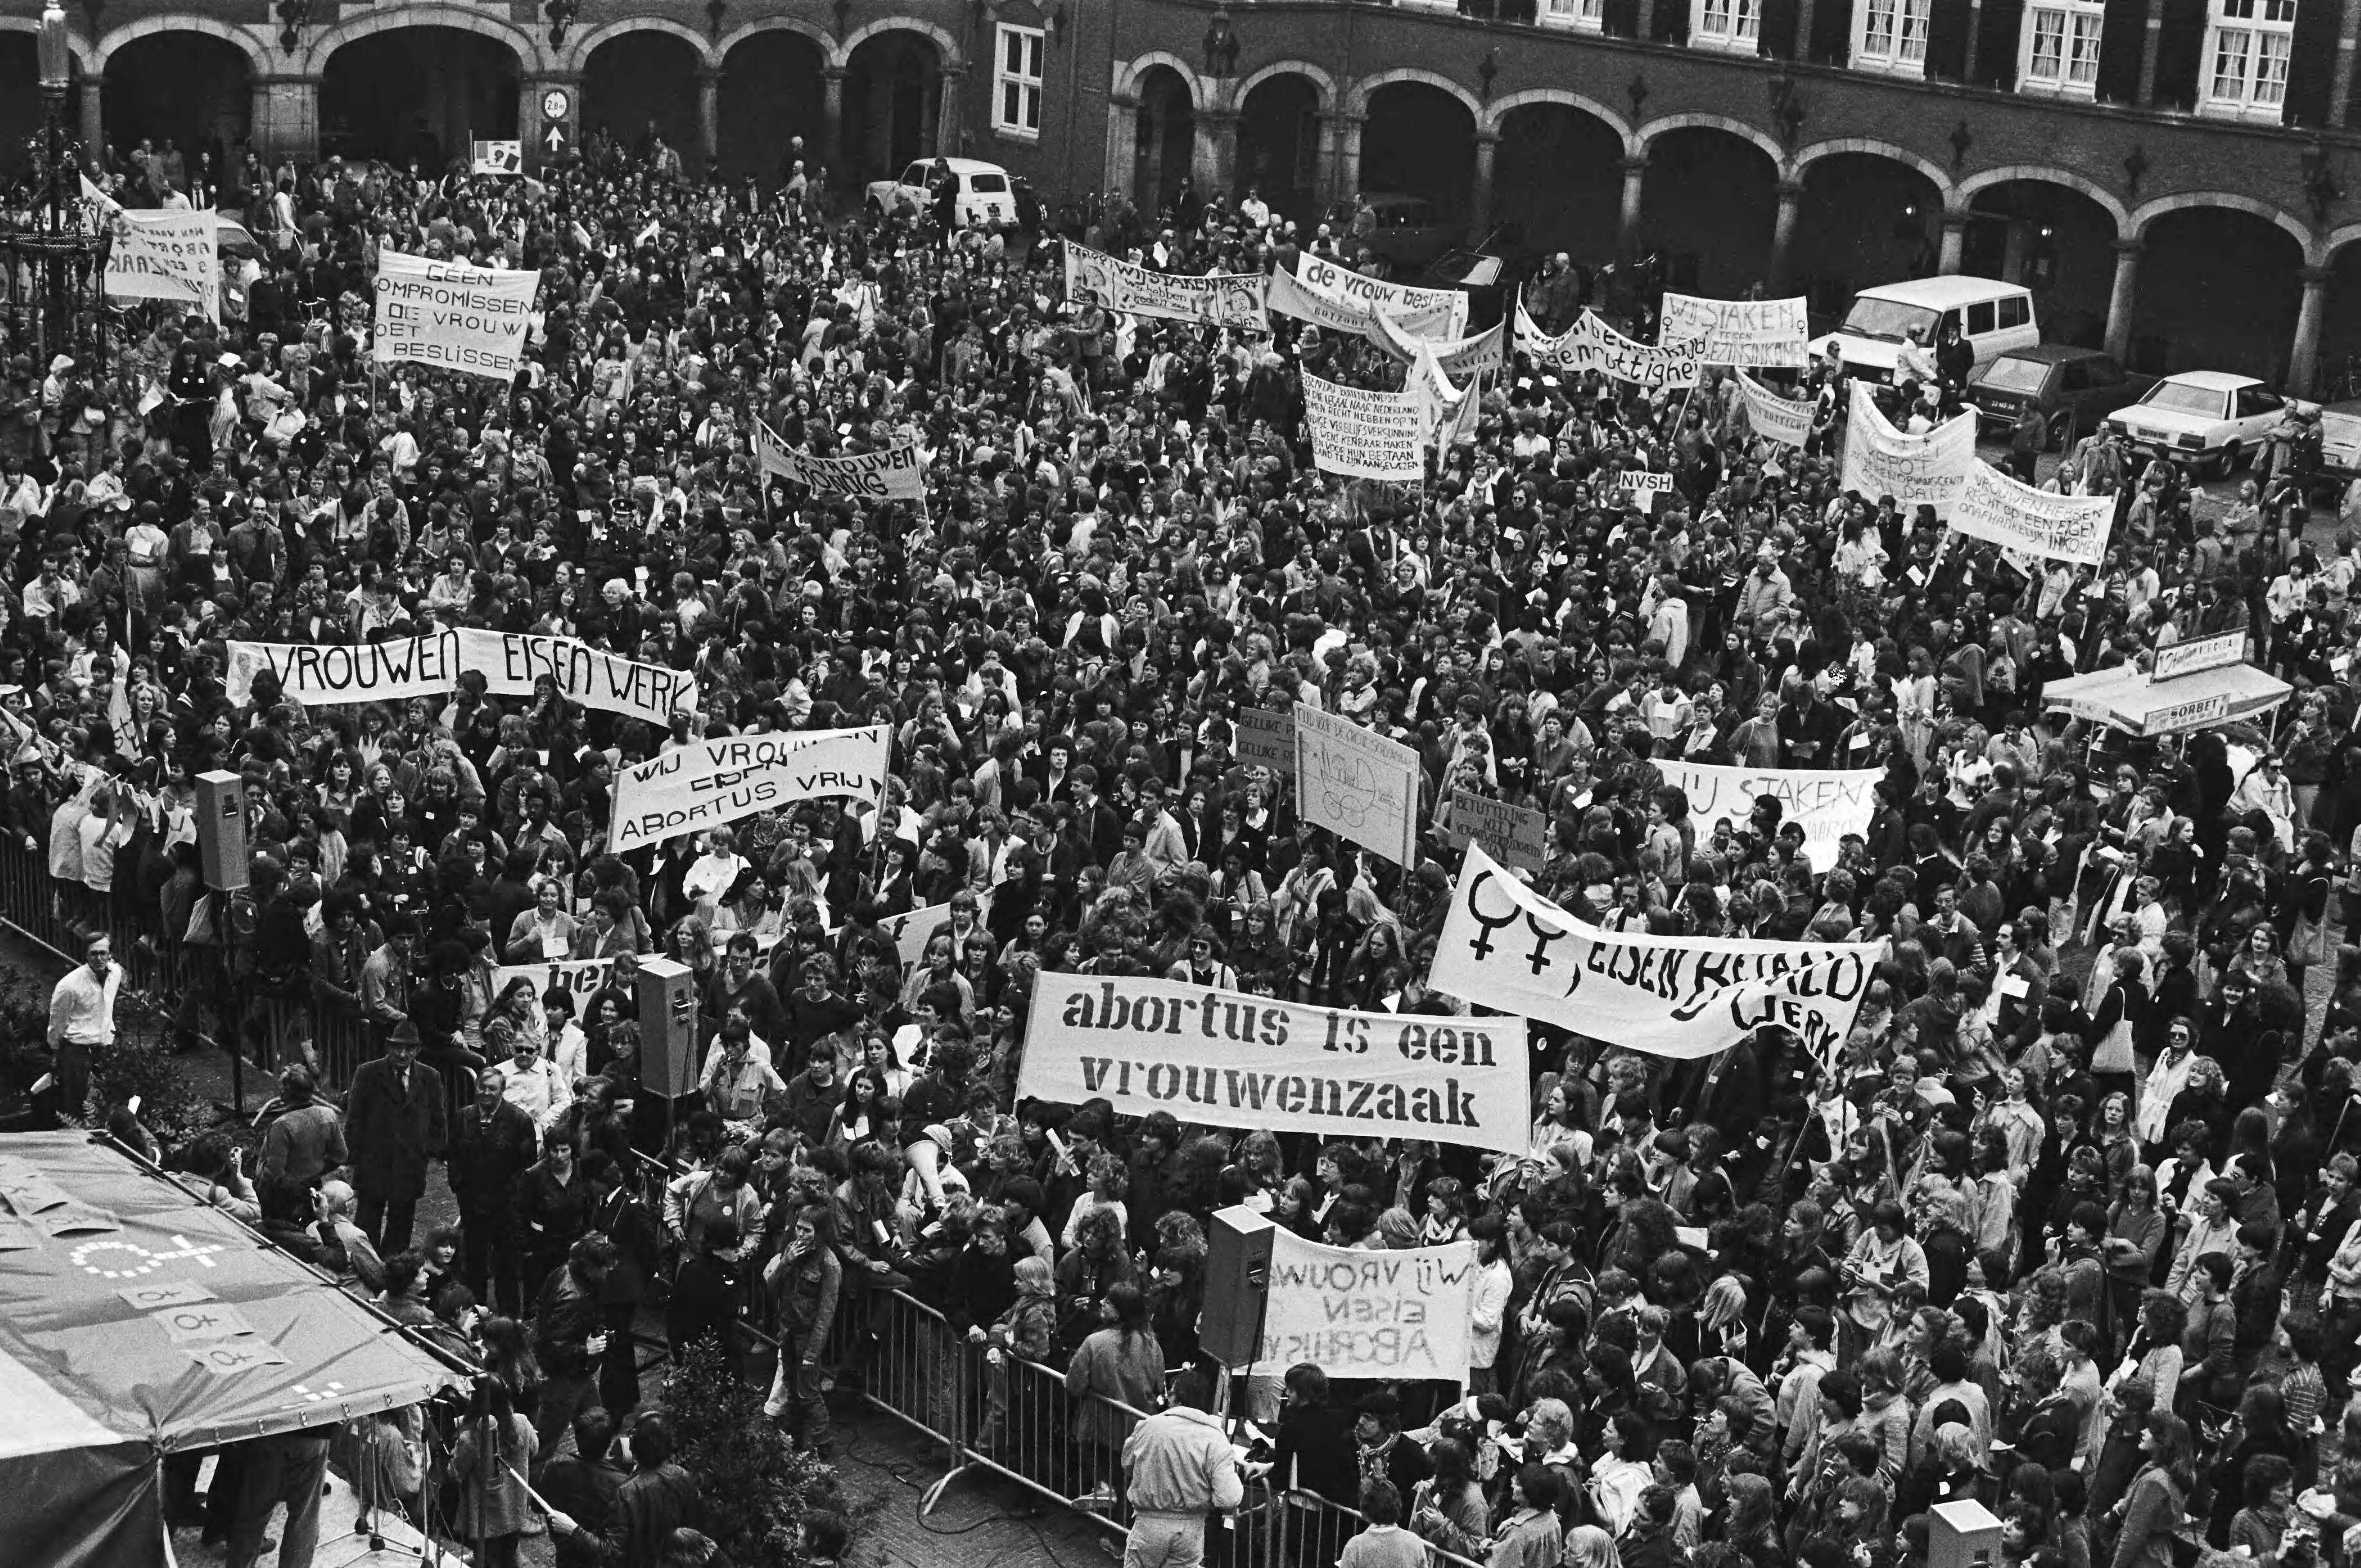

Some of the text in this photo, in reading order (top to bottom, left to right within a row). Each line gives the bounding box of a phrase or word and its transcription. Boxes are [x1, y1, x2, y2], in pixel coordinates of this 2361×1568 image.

[1307, 262, 1336, 288] de
[1344, 276, 1396, 305] vrouw
[434, 310, 522, 337] VROUW
[1355, 412, 1391, 425] HEBBEN
[1368, 449, 1414, 462] BESTAAN
[1383, 440, 1413, 449] MAKEN
[1621, 473, 1671, 490] NVSH
[2024, 513, 2053, 530] EEN
[605, 655, 695, 717] WERK
[2170, 697, 2218, 720] SORBET
[633, 753, 681, 783] WIJ
[620, 780, 777, 842] ABORTUS
[1062, 981, 1498, 1068] abortus is een
[1079, 1055, 1482, 1129] vrouwenzaak
